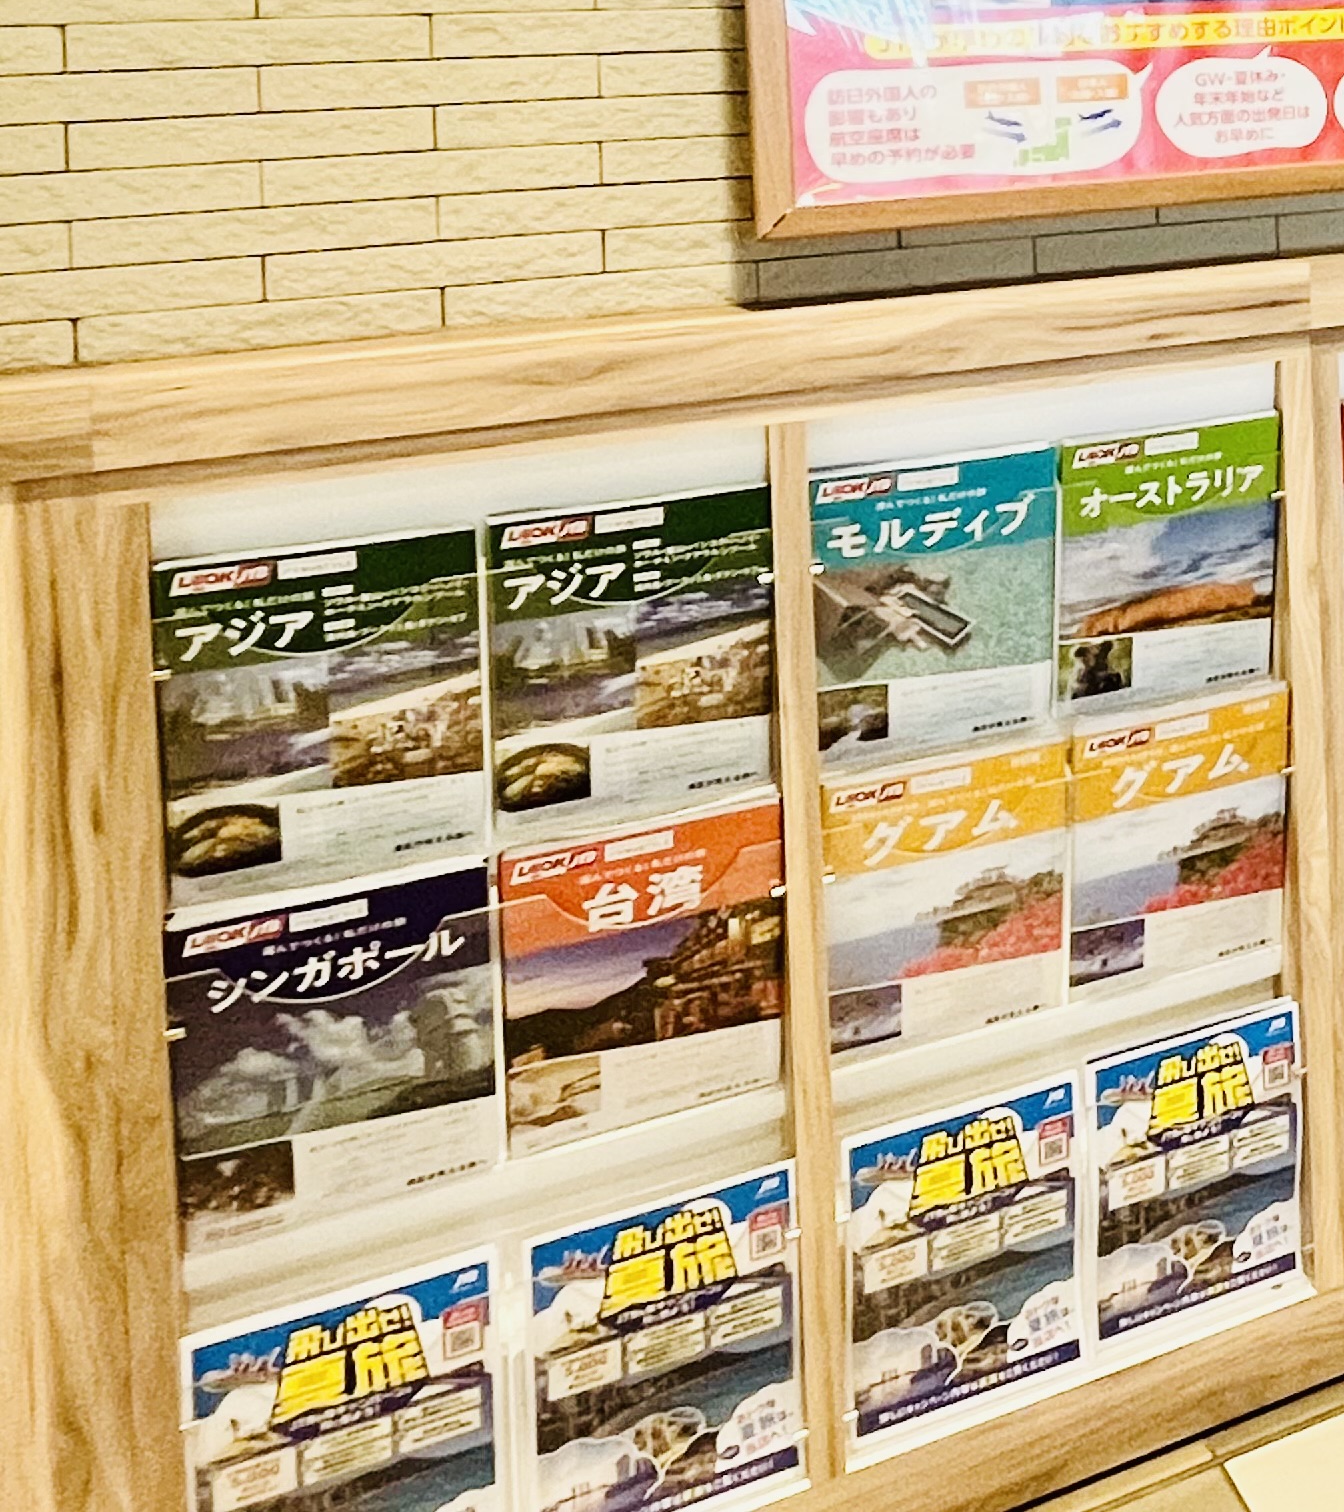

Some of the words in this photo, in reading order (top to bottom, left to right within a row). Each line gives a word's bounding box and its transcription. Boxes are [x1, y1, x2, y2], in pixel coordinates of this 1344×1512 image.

[826, 493, 1036, 558] モルディブ
[1080, 464, 1265, 519] オーストラリア
[503, 562, 627, 610] アジア
[174, 610, 315, 662] アジア
[1111, 743, 1250, 809] グアム
[862, 798, 1020, 868] グアム
[582, 864, 704, 932] 台湾
[206, 930, 466, 1014] シンガポール
[1147, 1063, 1255, 1136] 夏旅
[908, 1139, 1029, 1218] 夏旅
[600, 1230, 739, 1321] 夏旅
[270, 1327, 431, 1426] 夏旅
